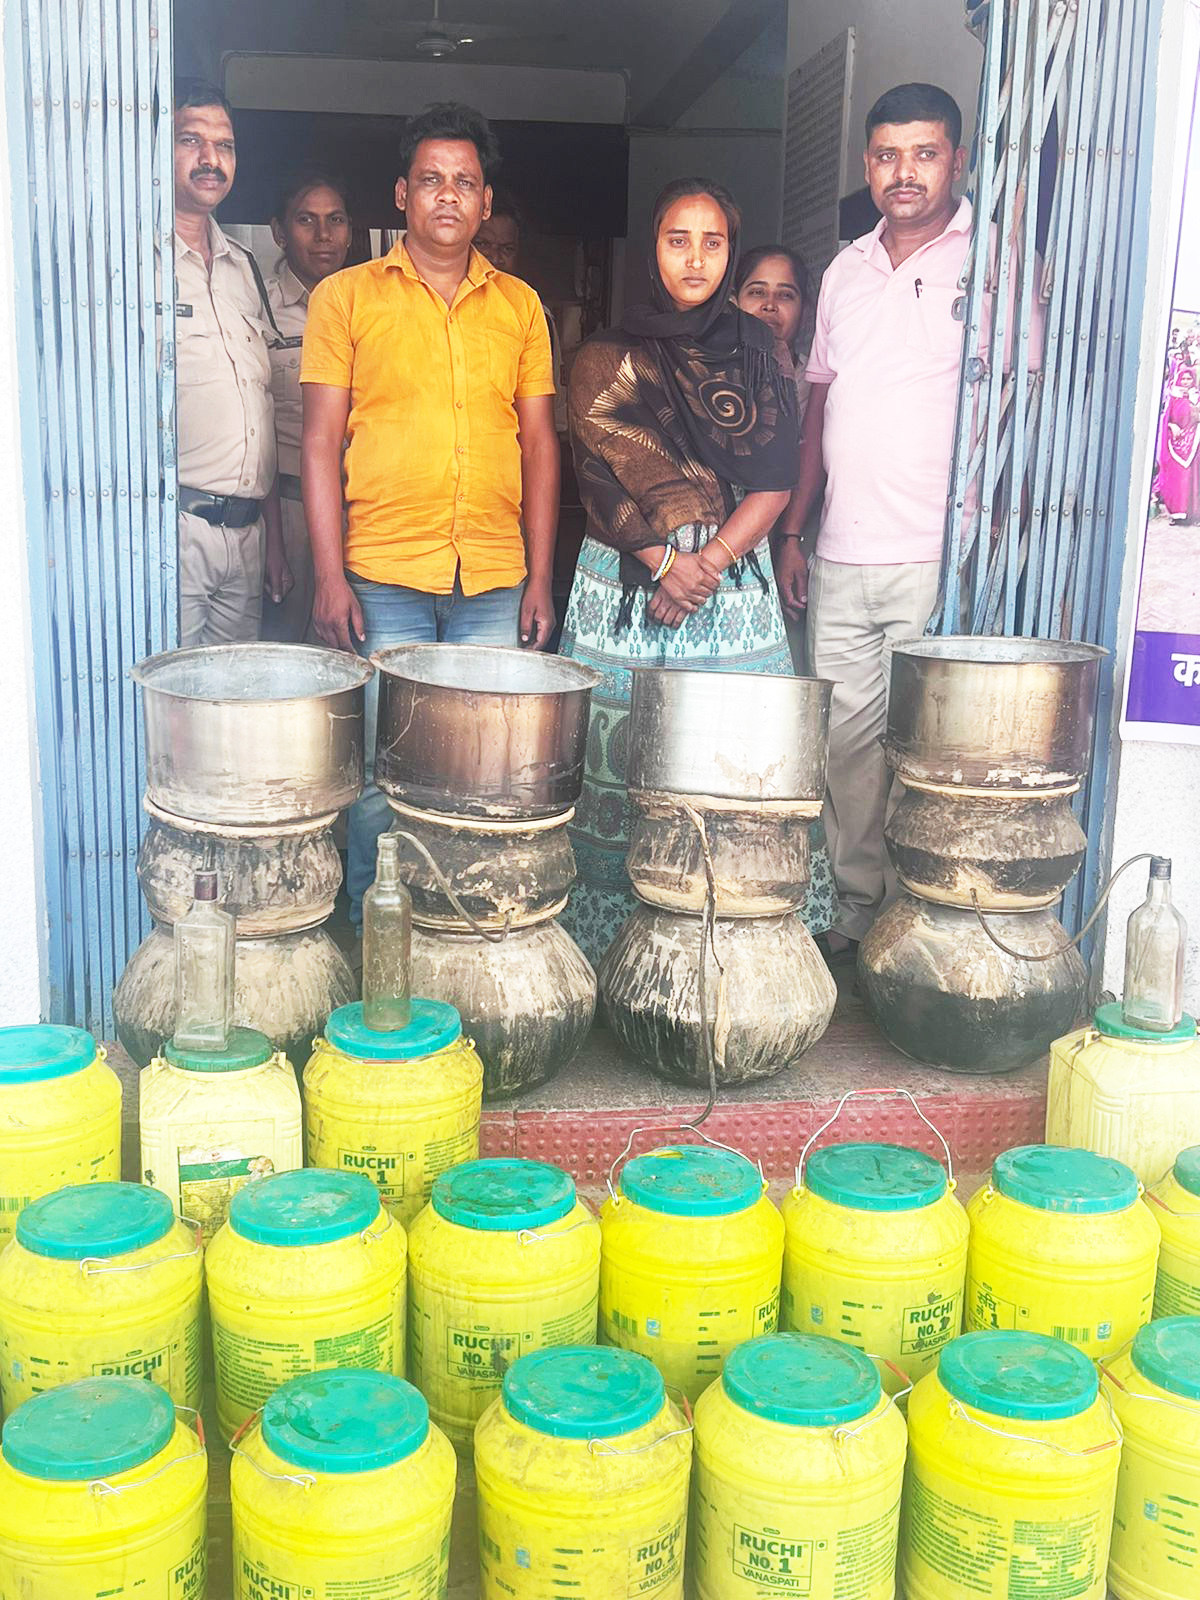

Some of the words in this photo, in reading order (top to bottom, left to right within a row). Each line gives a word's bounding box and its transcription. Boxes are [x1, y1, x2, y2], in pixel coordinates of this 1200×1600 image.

[344, 1154, 396, 1169] RUCHI
[376, 1170, 388, 1184] 1
[910, 1300, 953, 1323] RUCHI
[917, 1324, 937, 1338] NO.
[453, 1333, 511, 1350] RUCHI
[462, 1351, 486, 1366] NO.
[636, 1524, 681, 1562] RUCHI
[739, 1531, 803, 1558] RUCHI
[645, 1557, 665, 1576] NO.
[749, 1552, 774, 1571] NO.
[778, 1557, 792, 1574] 1
[243, 1560, 290, 1600] RUCHI
[742, 1567, 800, 1588] VANASPATI
